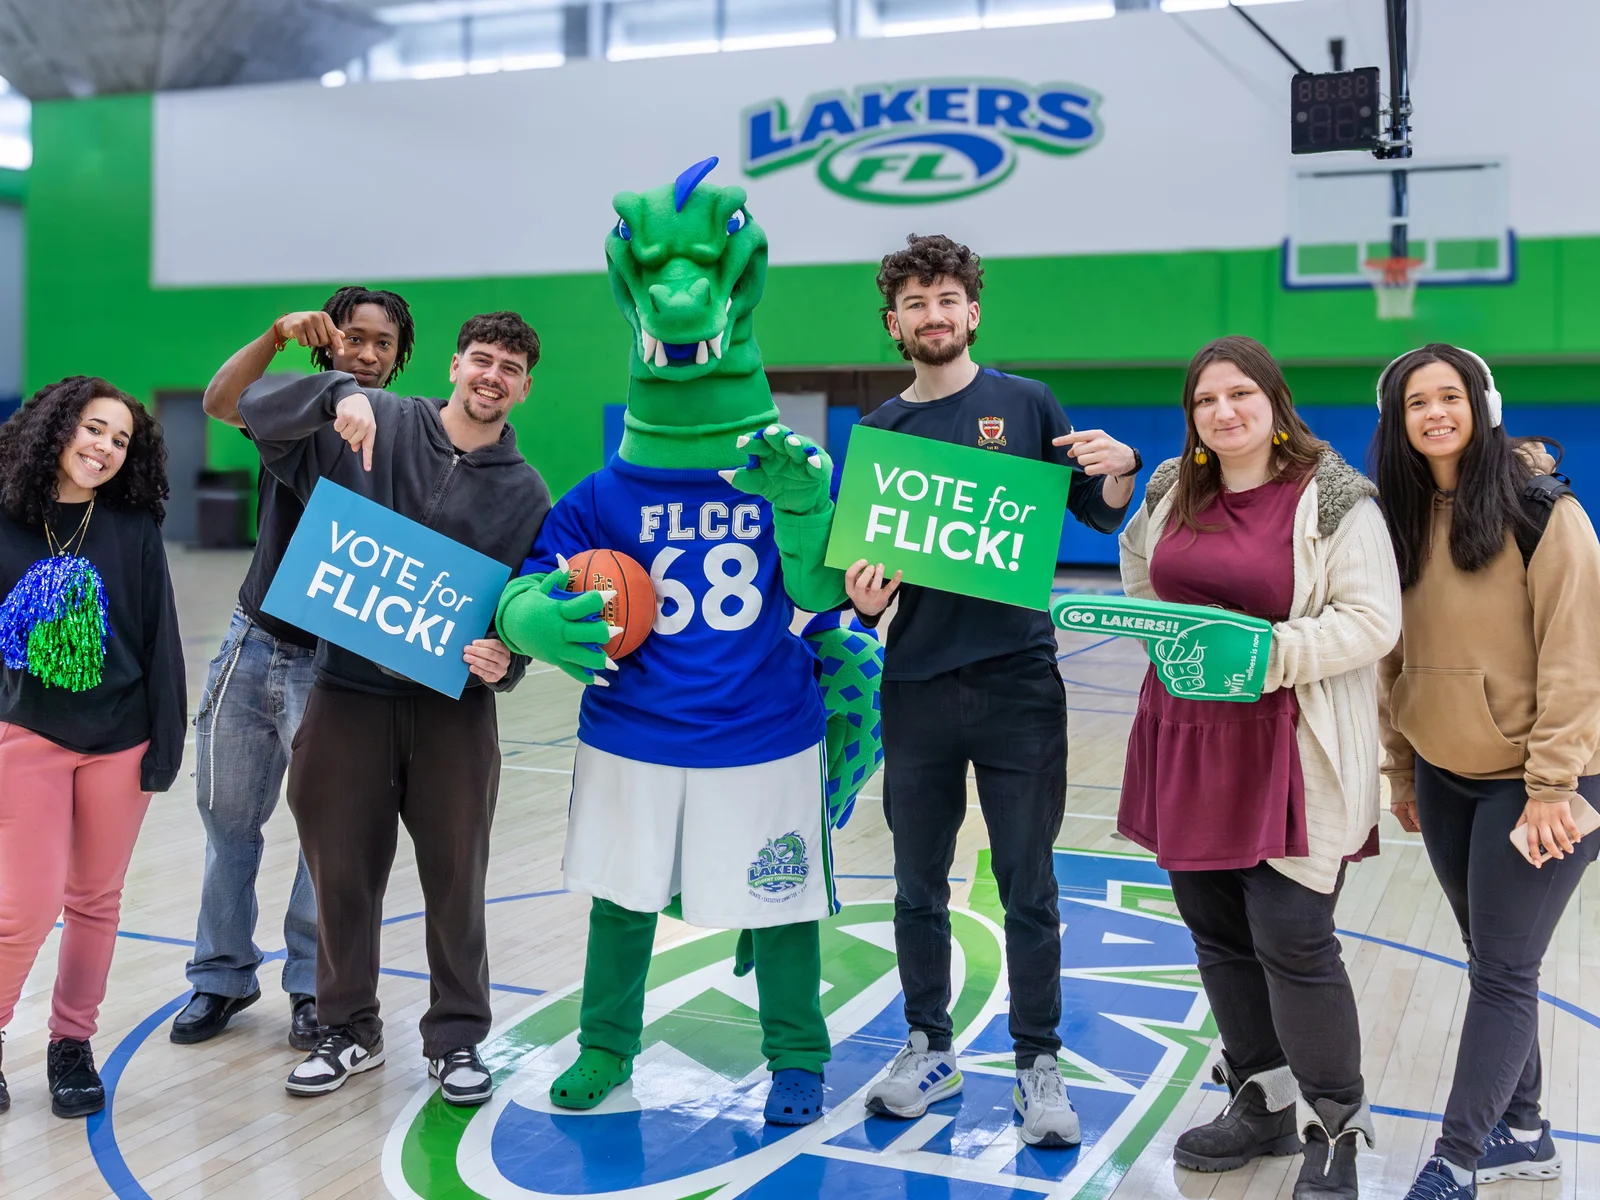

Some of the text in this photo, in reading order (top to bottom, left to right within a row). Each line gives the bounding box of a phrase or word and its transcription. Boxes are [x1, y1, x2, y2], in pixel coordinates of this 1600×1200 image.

[748, 85, 1096, 163] LAKERS
[852, 152, 963, 184] FL
[873, 462, 1037, 525] VOTE for
[639, 501, 761, 543] FLCC
[864, 503, 1024, 572] FLICK!
[331, 520, 473, 613] VOTE for
[306, 560, 456, 657] FLICK!
[650, 542, 763, 636] 68
[1067, 610, 1180, 634] GO LAKERS!!
[1229, 672, 1246, 694] win
[1245, 655, 1257, 681] wellness
[749, 865, 808, 881] LAKERS
[754, 877, 774, 887] STUDENT
